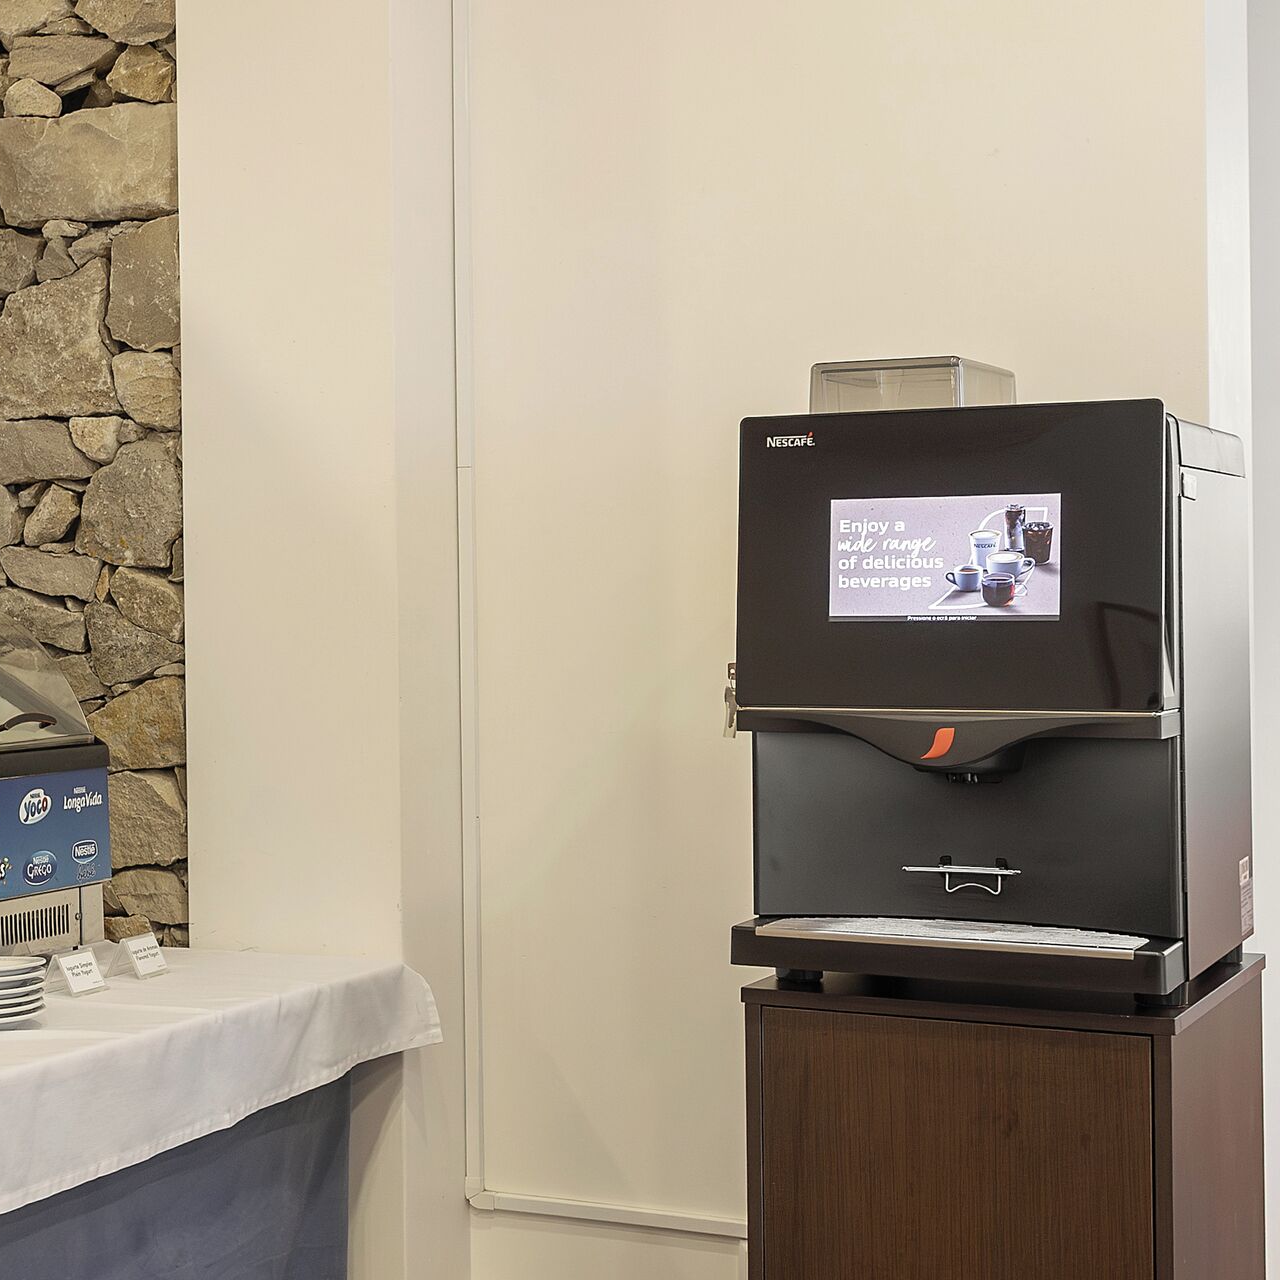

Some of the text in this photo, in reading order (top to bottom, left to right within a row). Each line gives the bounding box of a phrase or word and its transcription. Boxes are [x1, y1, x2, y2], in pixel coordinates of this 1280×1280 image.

[839, 518, 905, 537] Enjoy a
[837, 531, 936, 559] wide range
[838, 554, 944, 570] of delicious
[838, 574, 932, 591] beverages
